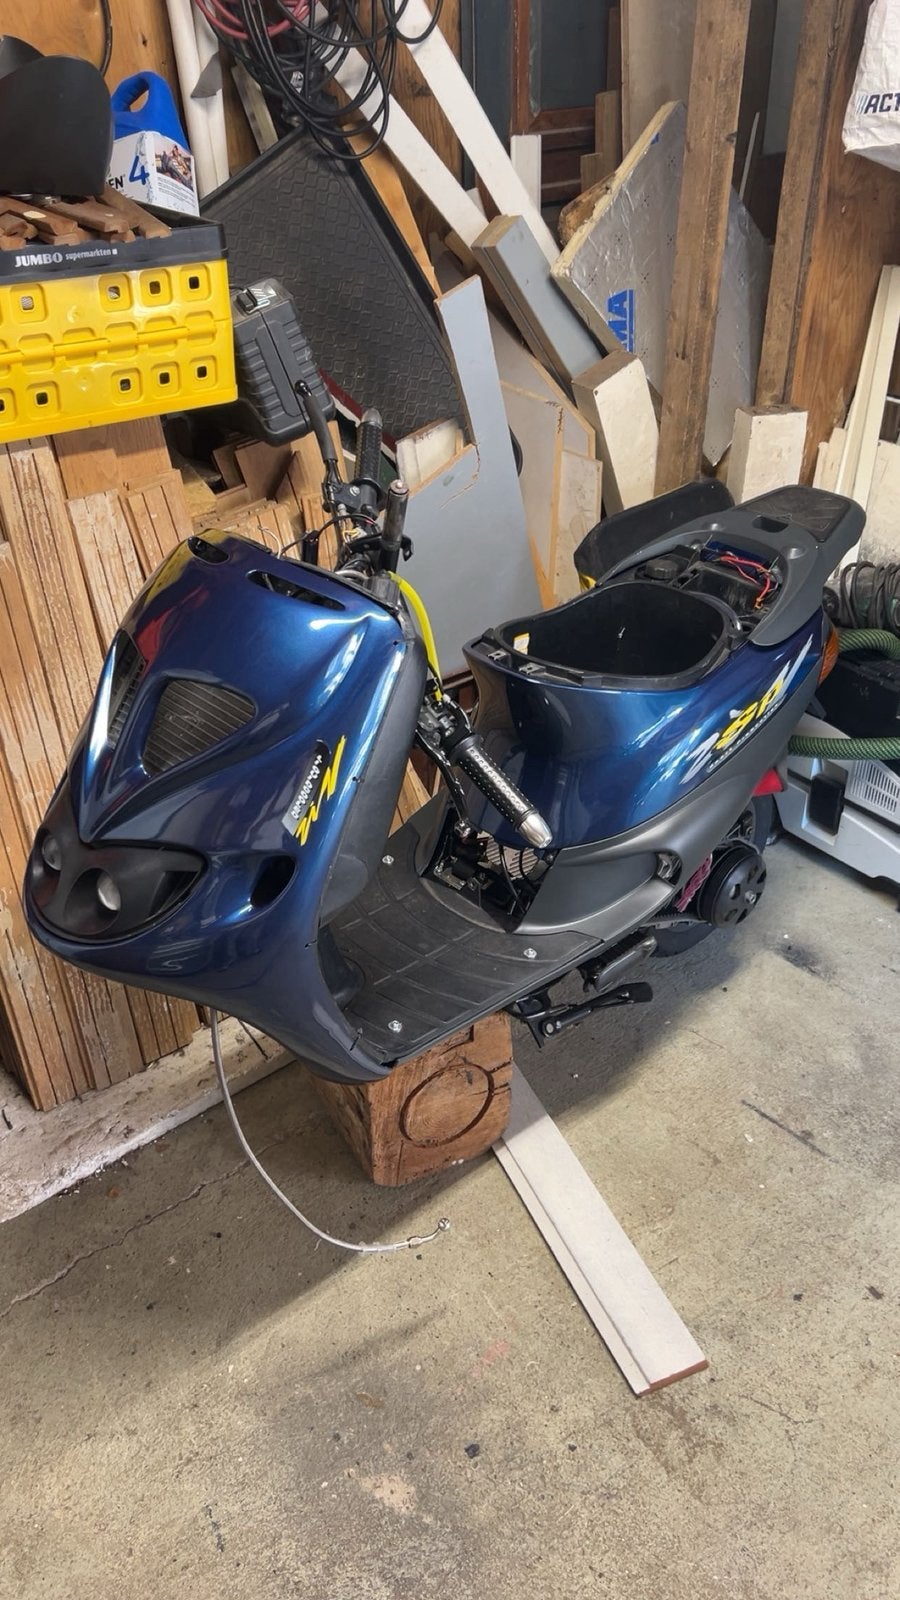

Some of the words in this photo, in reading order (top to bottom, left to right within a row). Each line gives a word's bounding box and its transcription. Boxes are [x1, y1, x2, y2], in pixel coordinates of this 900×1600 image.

[128, 155, 150, 185] 4
[15, 252, 63, 267] JUMBO
[65, 249, 111, 261] supermarkten
